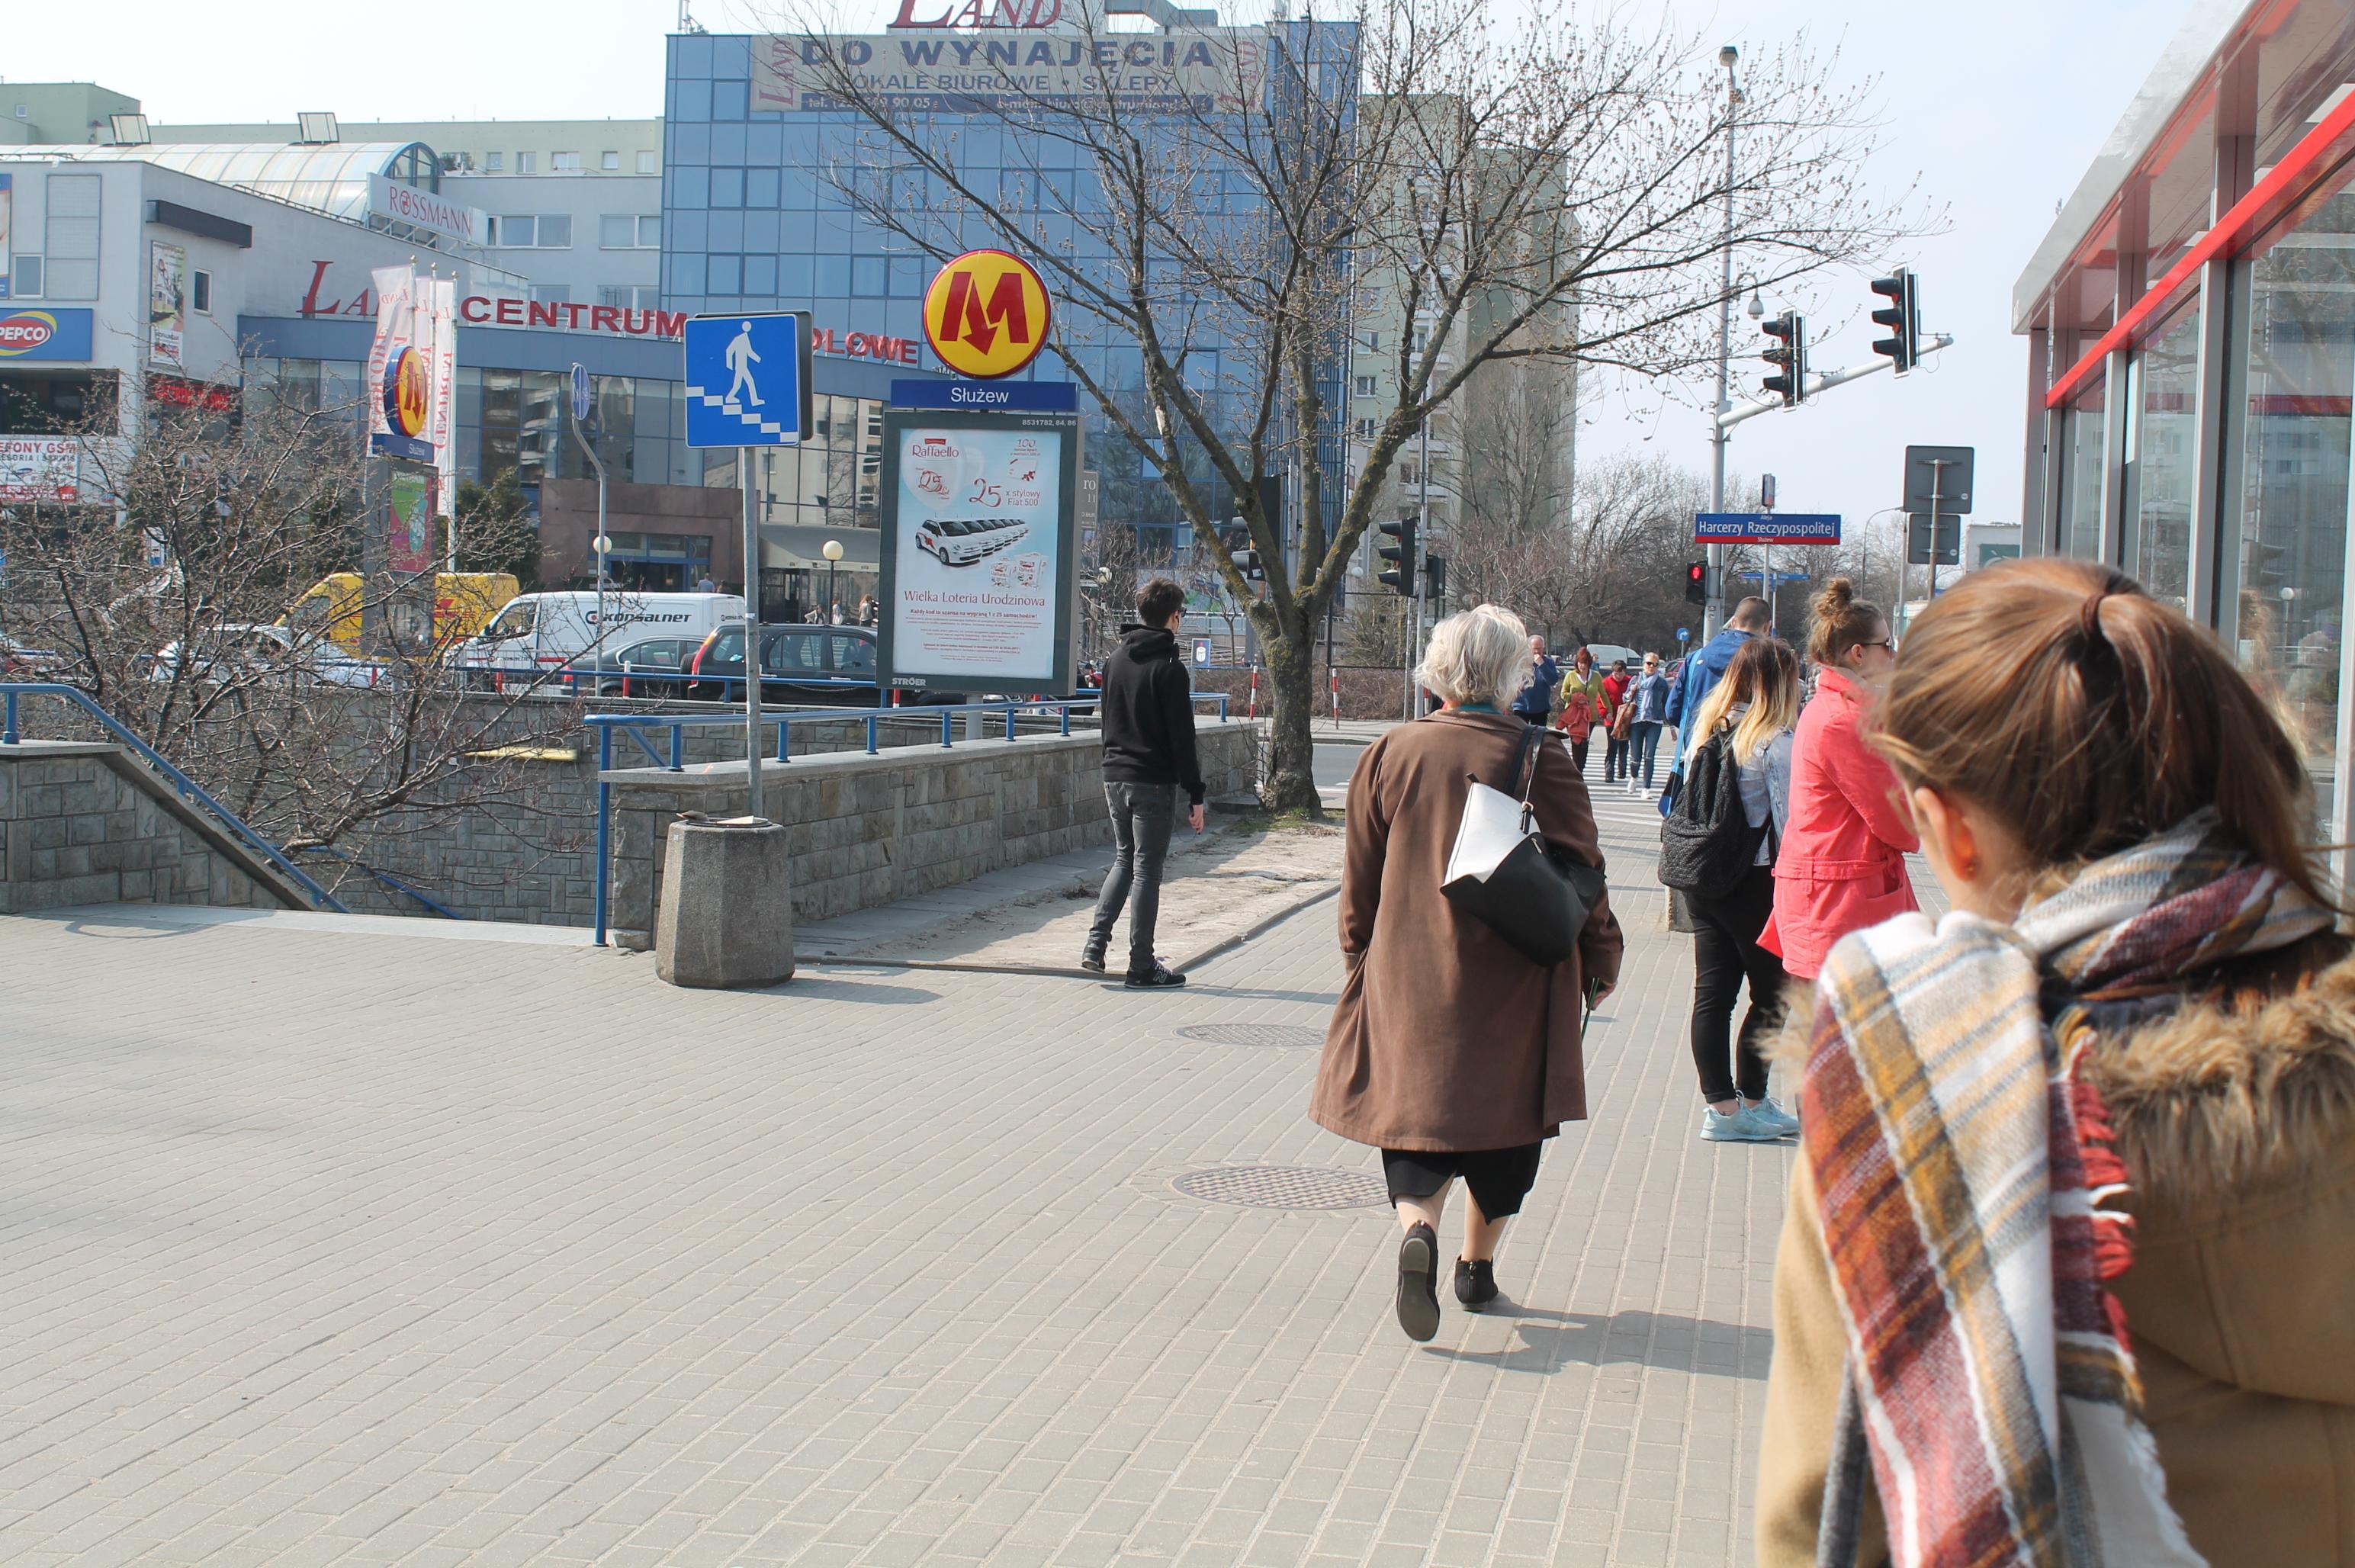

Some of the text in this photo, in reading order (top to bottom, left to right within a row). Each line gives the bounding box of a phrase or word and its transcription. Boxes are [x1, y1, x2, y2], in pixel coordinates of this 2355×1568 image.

[802, 40, 1216, 73] DO WYNAJĘCIA
[760, 40, 795, 107] LAND
[938, 75, 1049, 90] BIUROWE
[1083, 76, 1174, 91] SKLEPY
[892, 97, 910, 108] 90
[914, 97, 930, 108] 05
[390, 185, 471, 236] ROSSMANN
[295, 260, 379, 316] LA
[460, 296, 687, 337] CENTRUM
[950, 387, 1009, 403] Służew
[911, 445, 959, 458] Raffaello
[969, 478, 1001, 507] 25
[1011, 489, 1040, 499] stylowy
[1024, 498, 1039, 506] 500
[1698, 521, 1836, 537] Harcerzy Rzeczypospolitej
[904, 590, 1046, 606] Wielka Loteria Urodzinowa
[892, 677, 927, 686] STRÖER
